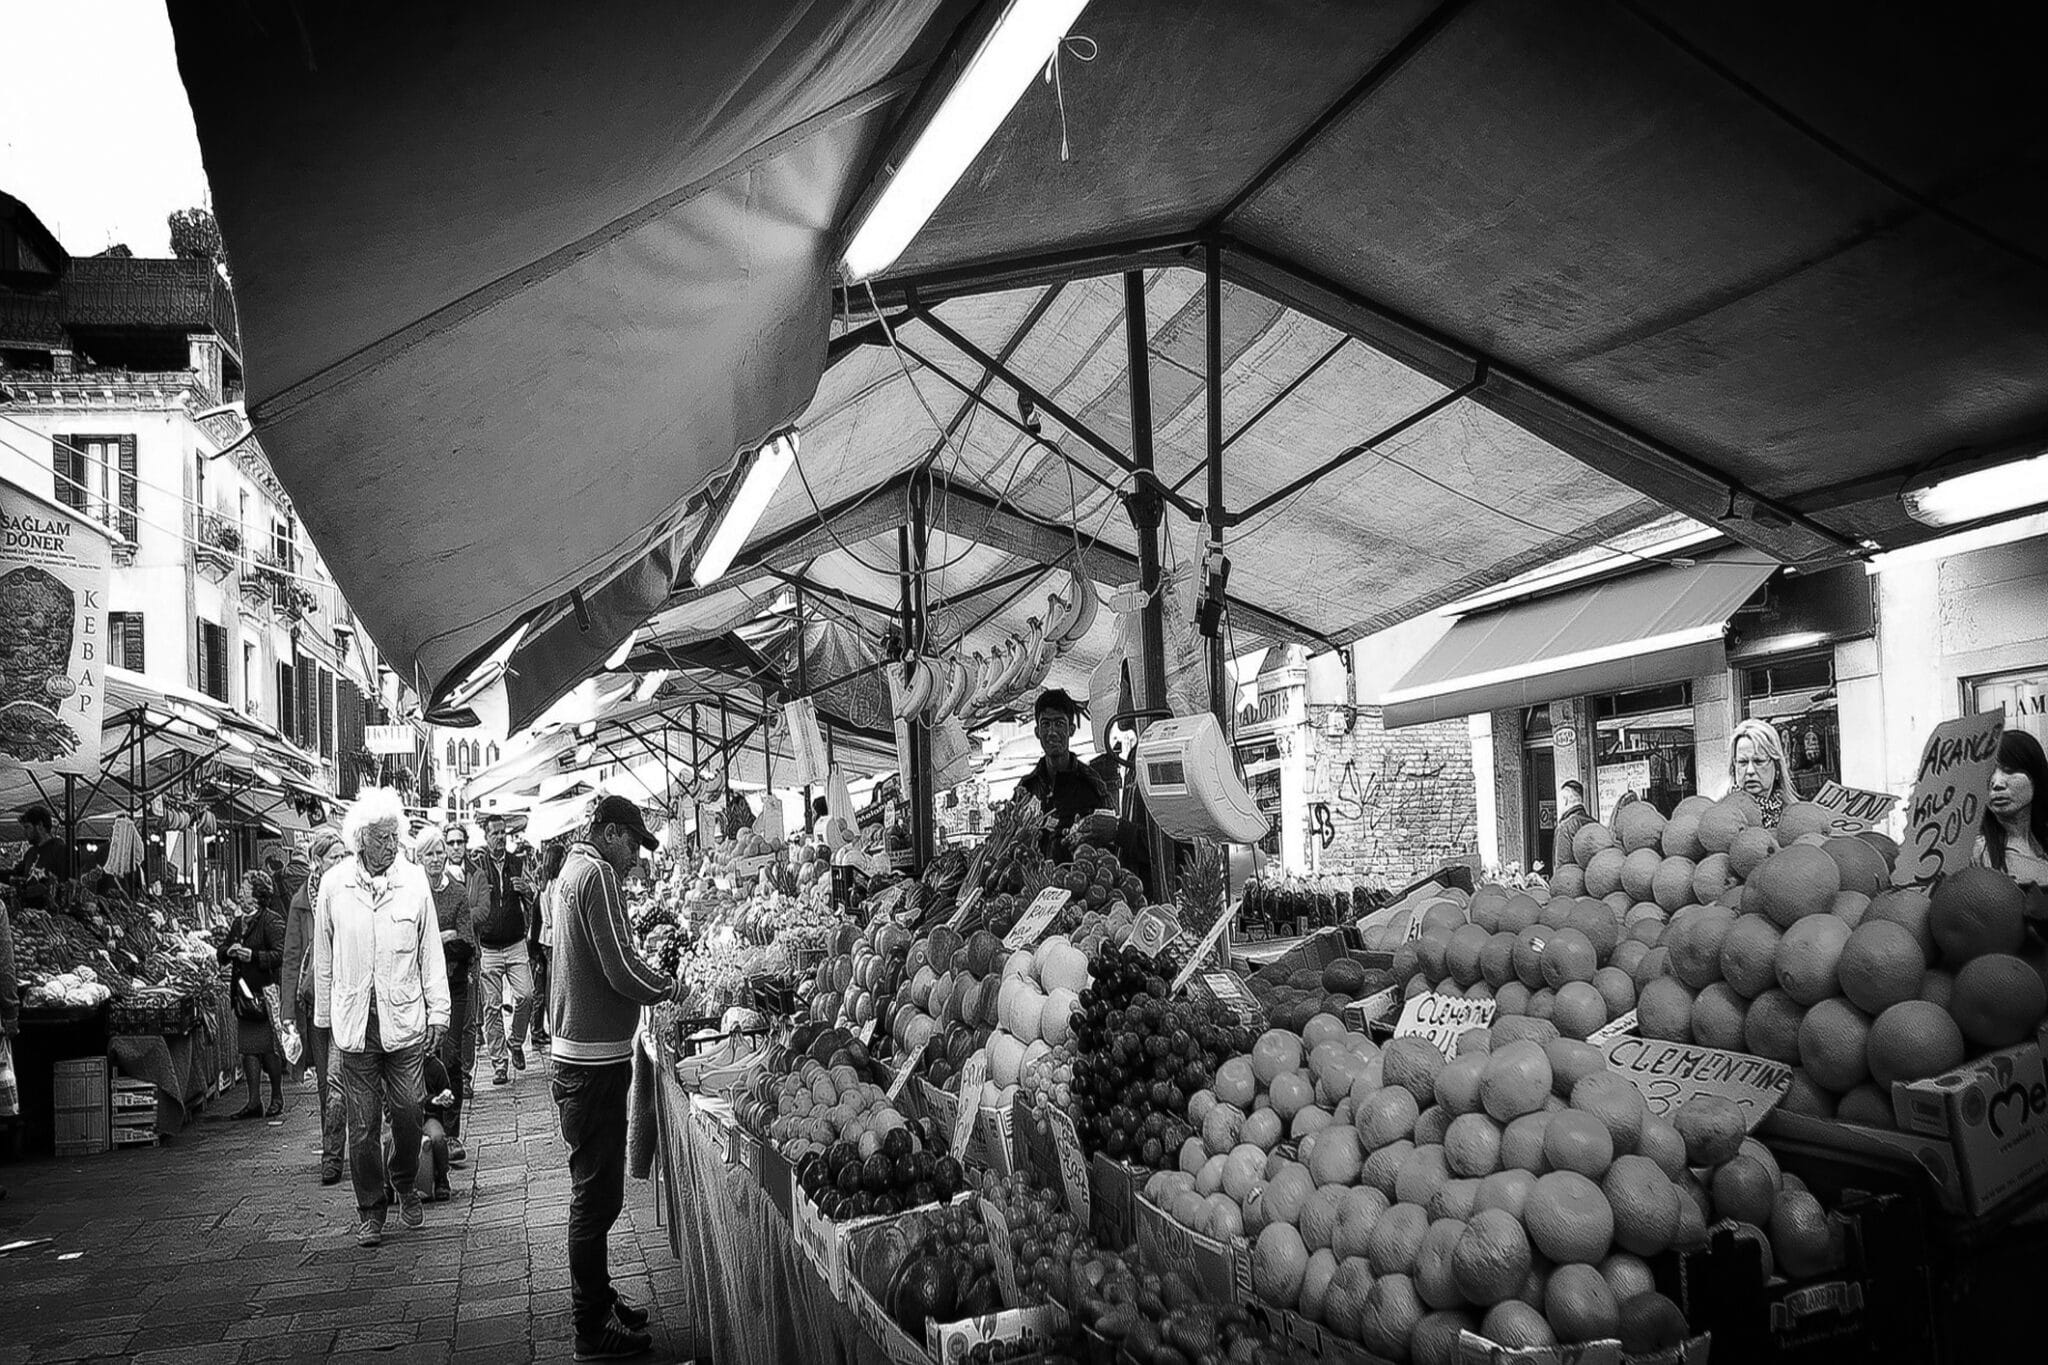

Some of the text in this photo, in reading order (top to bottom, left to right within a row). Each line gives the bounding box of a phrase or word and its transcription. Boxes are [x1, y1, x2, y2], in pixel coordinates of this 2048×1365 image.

[0, 514, 71, 537] SAĞLAM
[6, 531, 64, 552] DÖNER
[79, 589, 100, 713] KEBAP
[1816, 785, 1892, 821] LIMONI
[1912, 785, 1956, 828] KILO
[1608, 1039, 1794, 1093] CLEMENTINE
